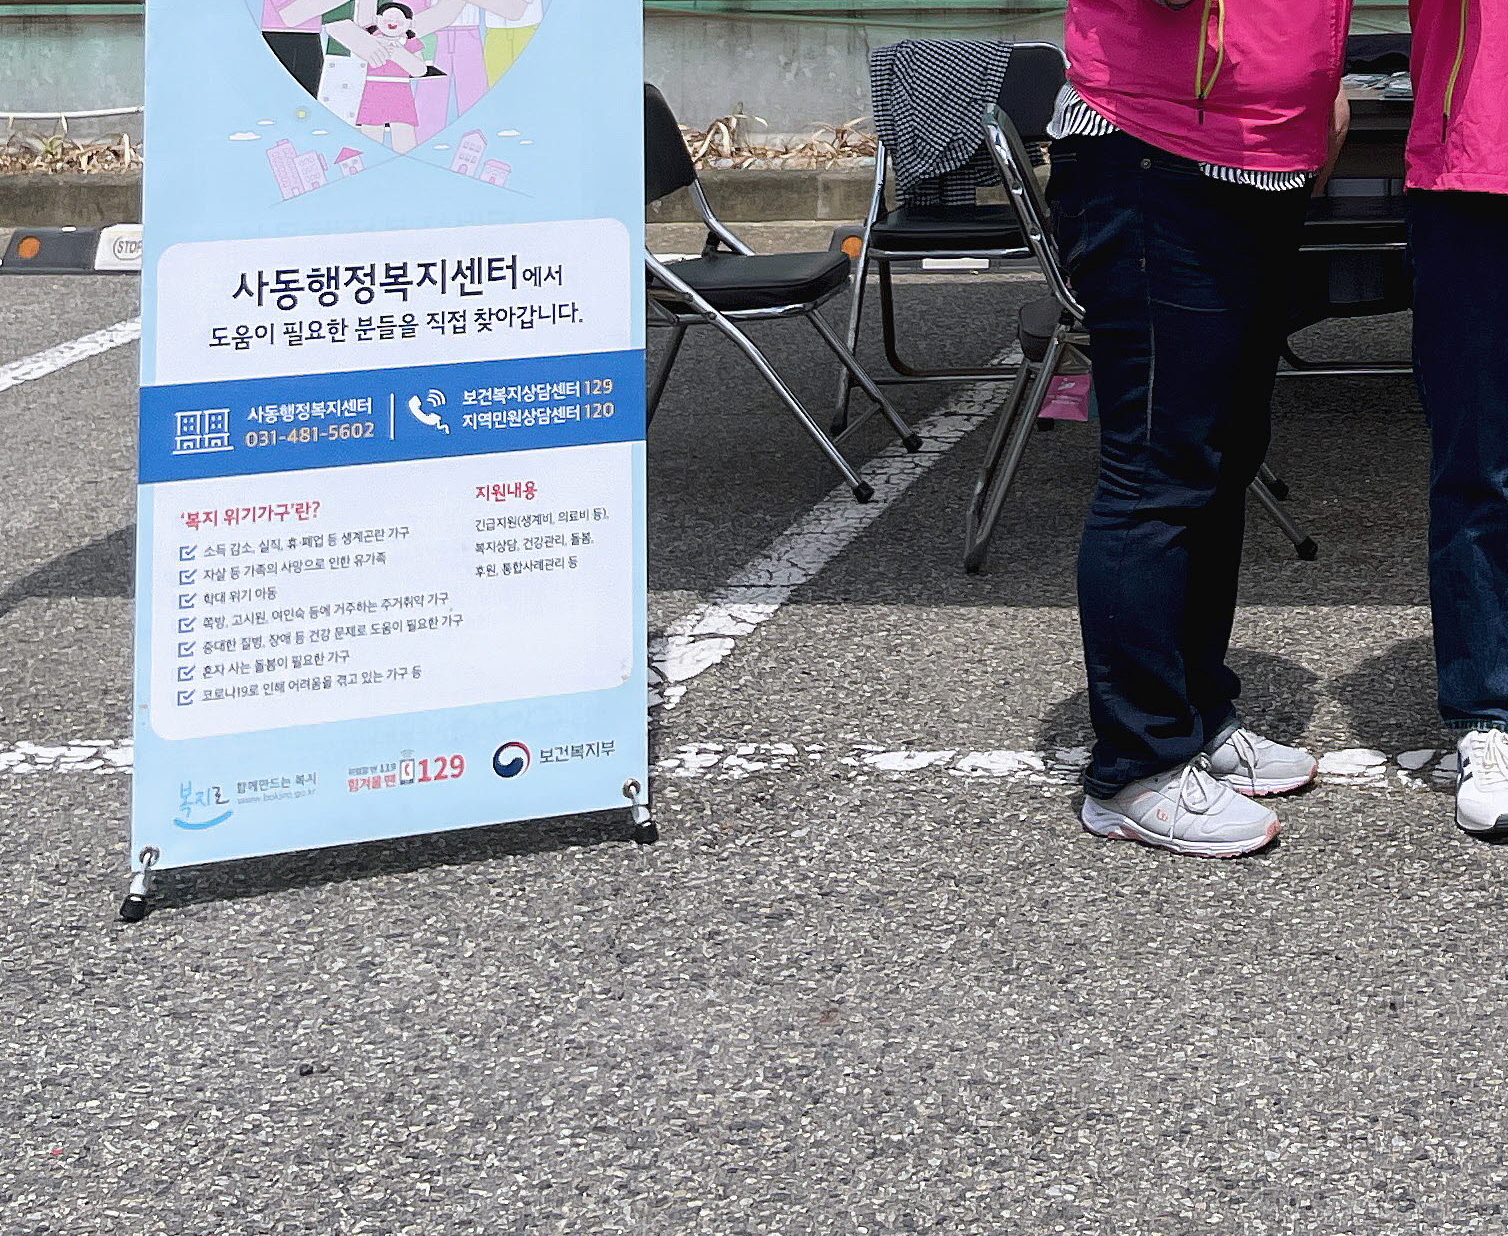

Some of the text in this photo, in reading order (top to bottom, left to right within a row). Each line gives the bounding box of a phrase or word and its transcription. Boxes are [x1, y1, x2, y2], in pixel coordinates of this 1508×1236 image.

[232, 255, 562, 311] 사동행정복지센터에서
[209, 302, 584, 350] 도움이 필요한 분들을 직접 찾아갑니다.
[461, 378, 614, 406] 보건복지상담센터 129
[246, 397, 373, 425] 사동행정복지센터
[461, 402, 615, 430] 지역민원상담센터 120
[244, 422, 375, 448] 031-481-5602
[475, 481, 538, 502] 지원내용
[558, 508, 589, 523] 의료비
[203, 543, 226, 557] 소득
[388, 526, 410, 539] 가구
[203, 566, 226, 581] 자살
[427, 592, 448, 606] 가구
[309, 628, 330, 643] 건강
[370, 620, 403, 635] 도움이
[441, 614, 463, 627] 가구
[228, 661, 251, 675] 사는
[327, 650, 350, 663] 가구
[361, 670, 384, 685] 있는
[387, 667, 408, 680] 가구
[411, 665, 422, 679] 등
[539, 740, 616, 764] 보건복지부
[417, 754, 465, 783] 129
